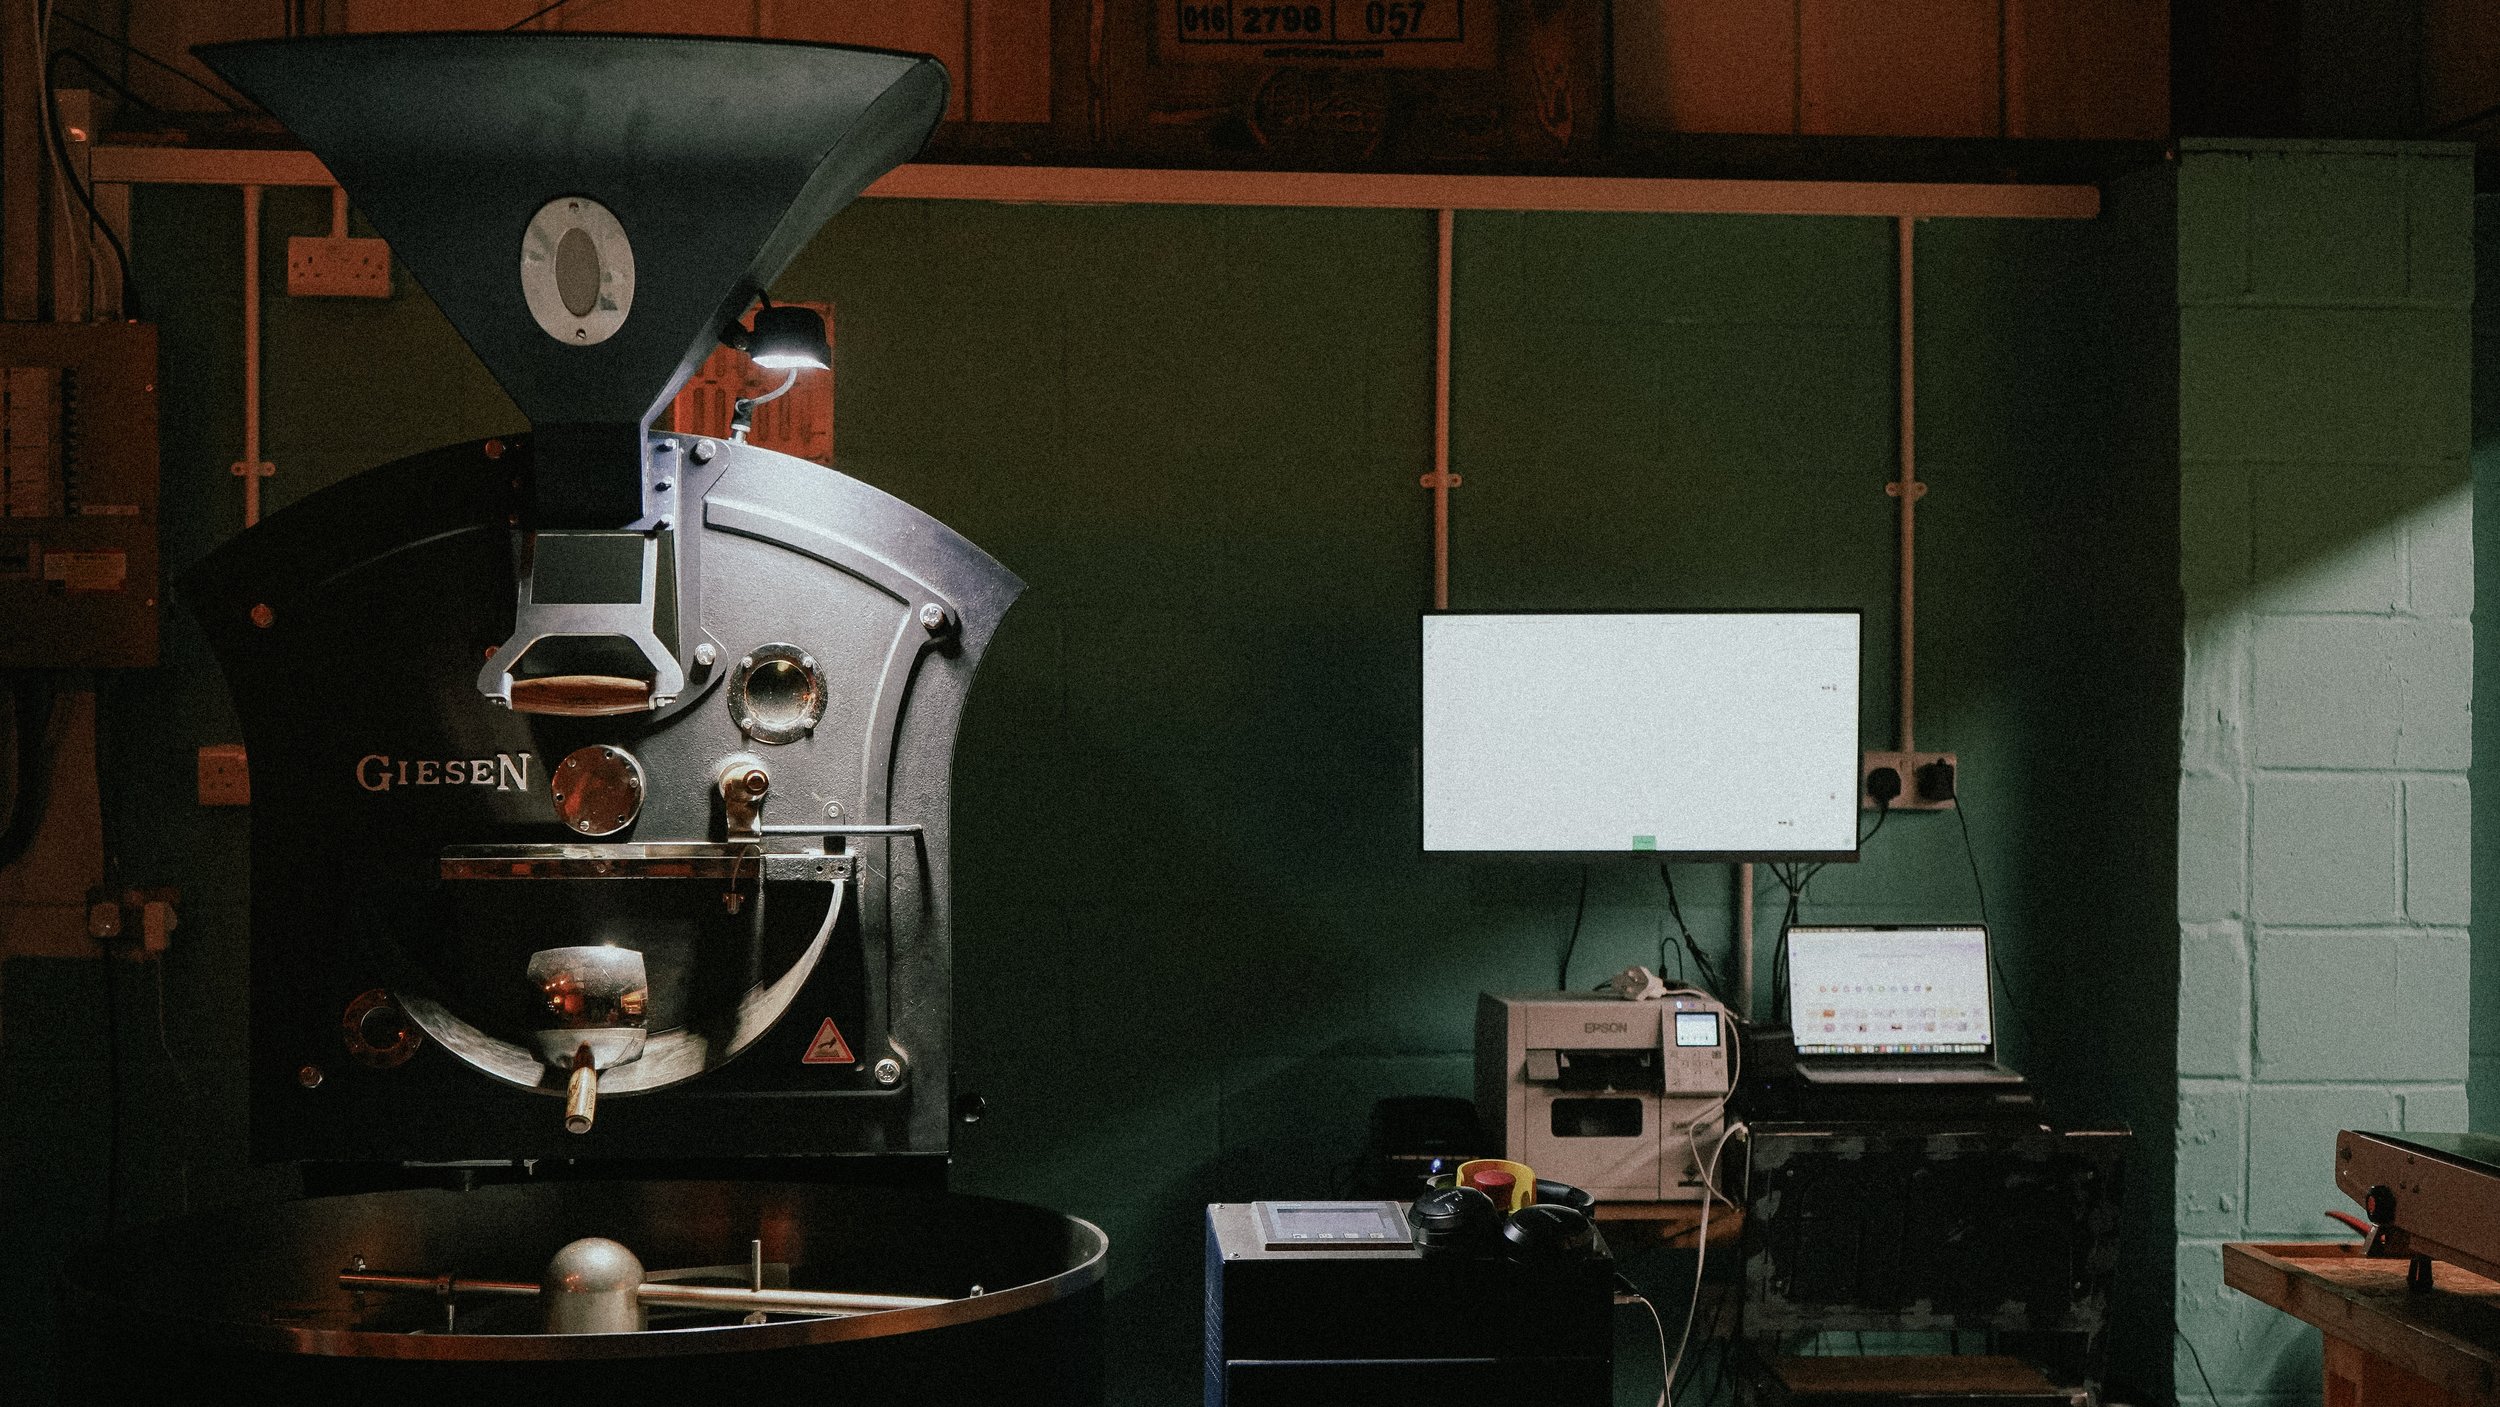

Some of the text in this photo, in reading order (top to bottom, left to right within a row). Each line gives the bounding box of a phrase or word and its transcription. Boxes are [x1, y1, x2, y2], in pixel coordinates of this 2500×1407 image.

[1184, 1, 1425, 36] 016 2798 057
[356, 752, 532, 792] GIESEN
[1584, 1022, 1628, 1034] EPSON
